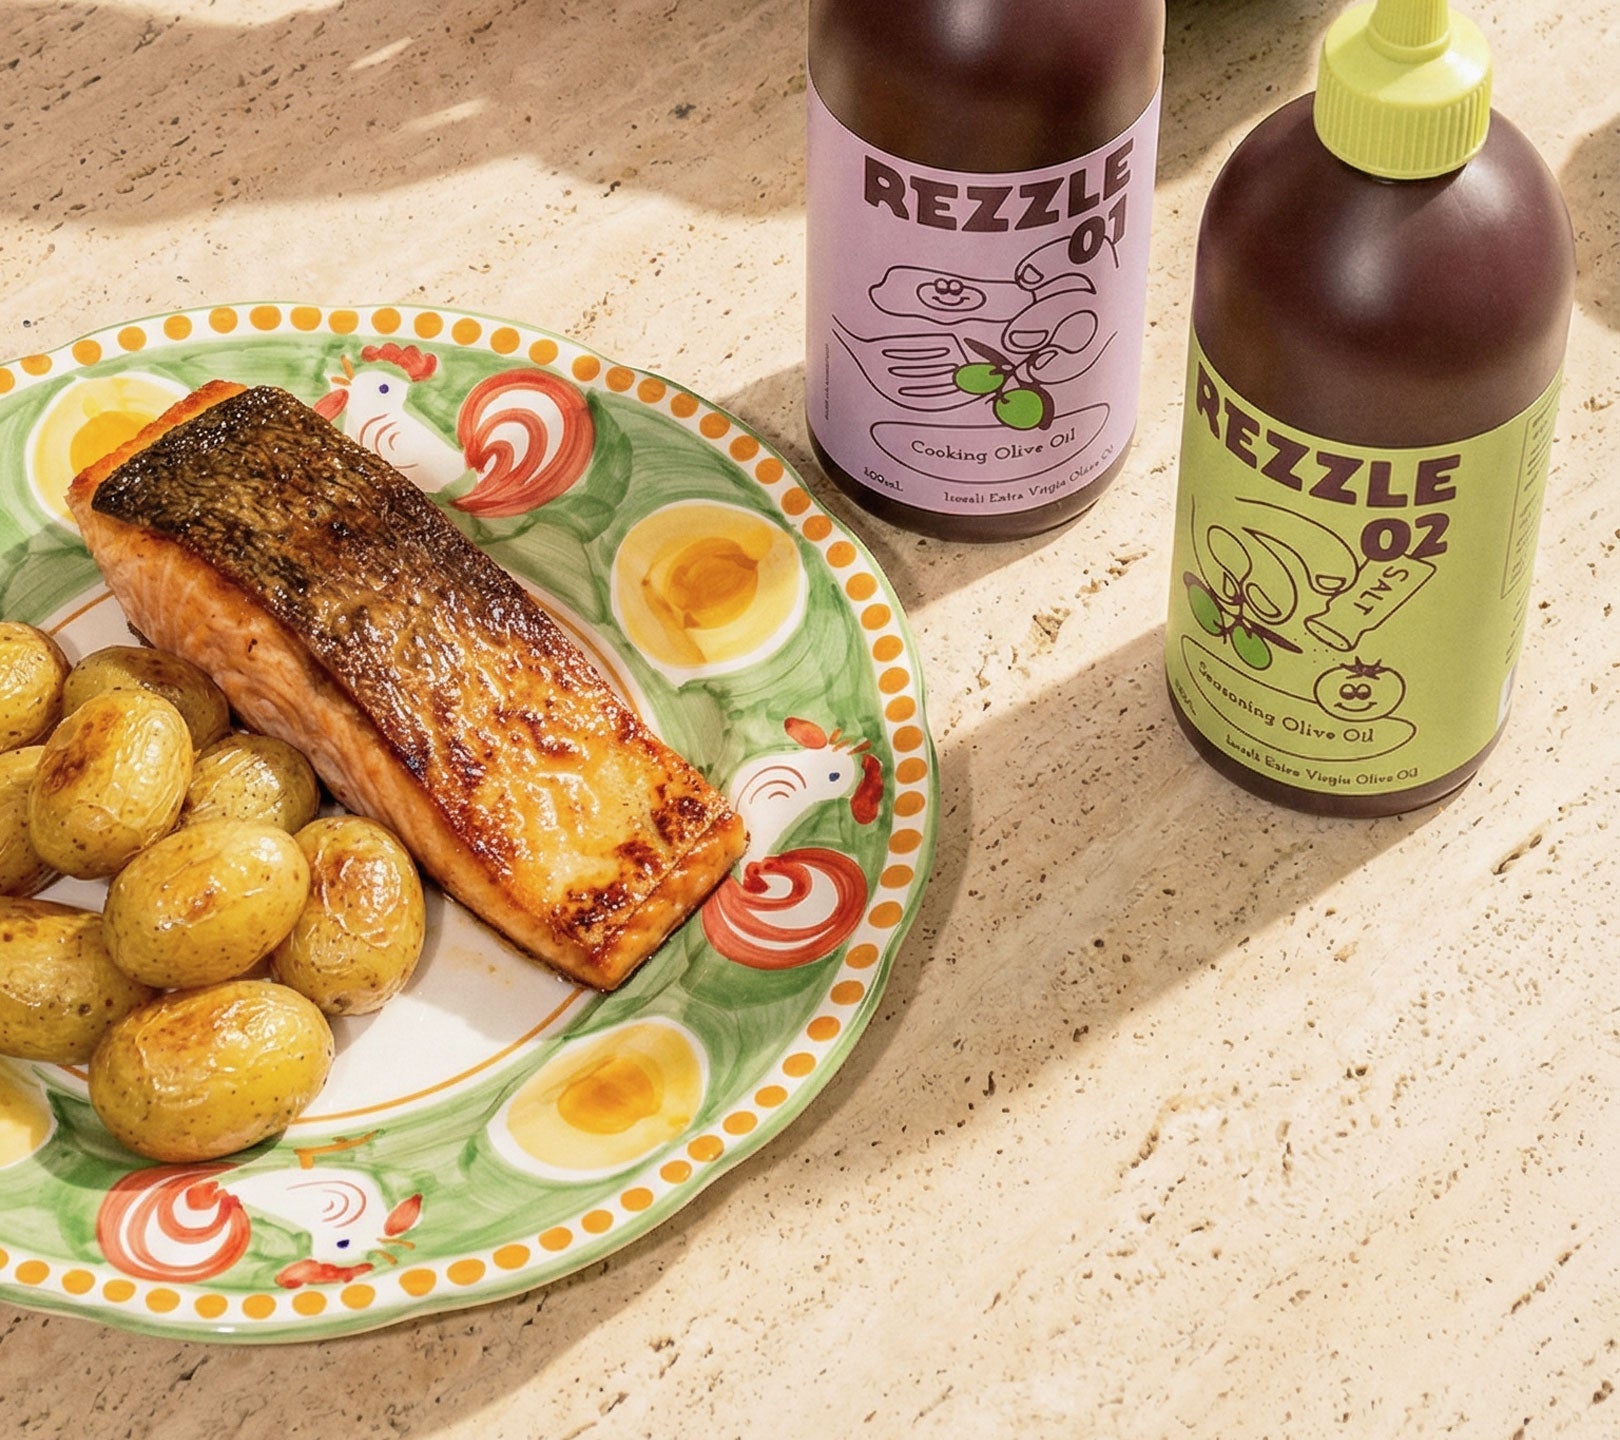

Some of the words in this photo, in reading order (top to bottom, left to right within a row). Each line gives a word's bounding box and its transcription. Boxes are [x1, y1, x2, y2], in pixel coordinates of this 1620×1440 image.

[864, 137, 1135, 232] REZZLE
[1068, 193, 1127, 264] 01
[911, 440, 988, 465] Cooking
[994, 444, 1044, 460] Olive
[1050, 427, 1076, 448] Oil
[1196, 360, 1462, 508] REZZLE
[1360, 512, 1450, 562] 02
[1353, 565, 1409, 616] SALT
[1198, 660, 1276, 727] Seasoning
[1282, 716, 1336, 740] Olive
[1343, 728, 1375, 743] Oil
